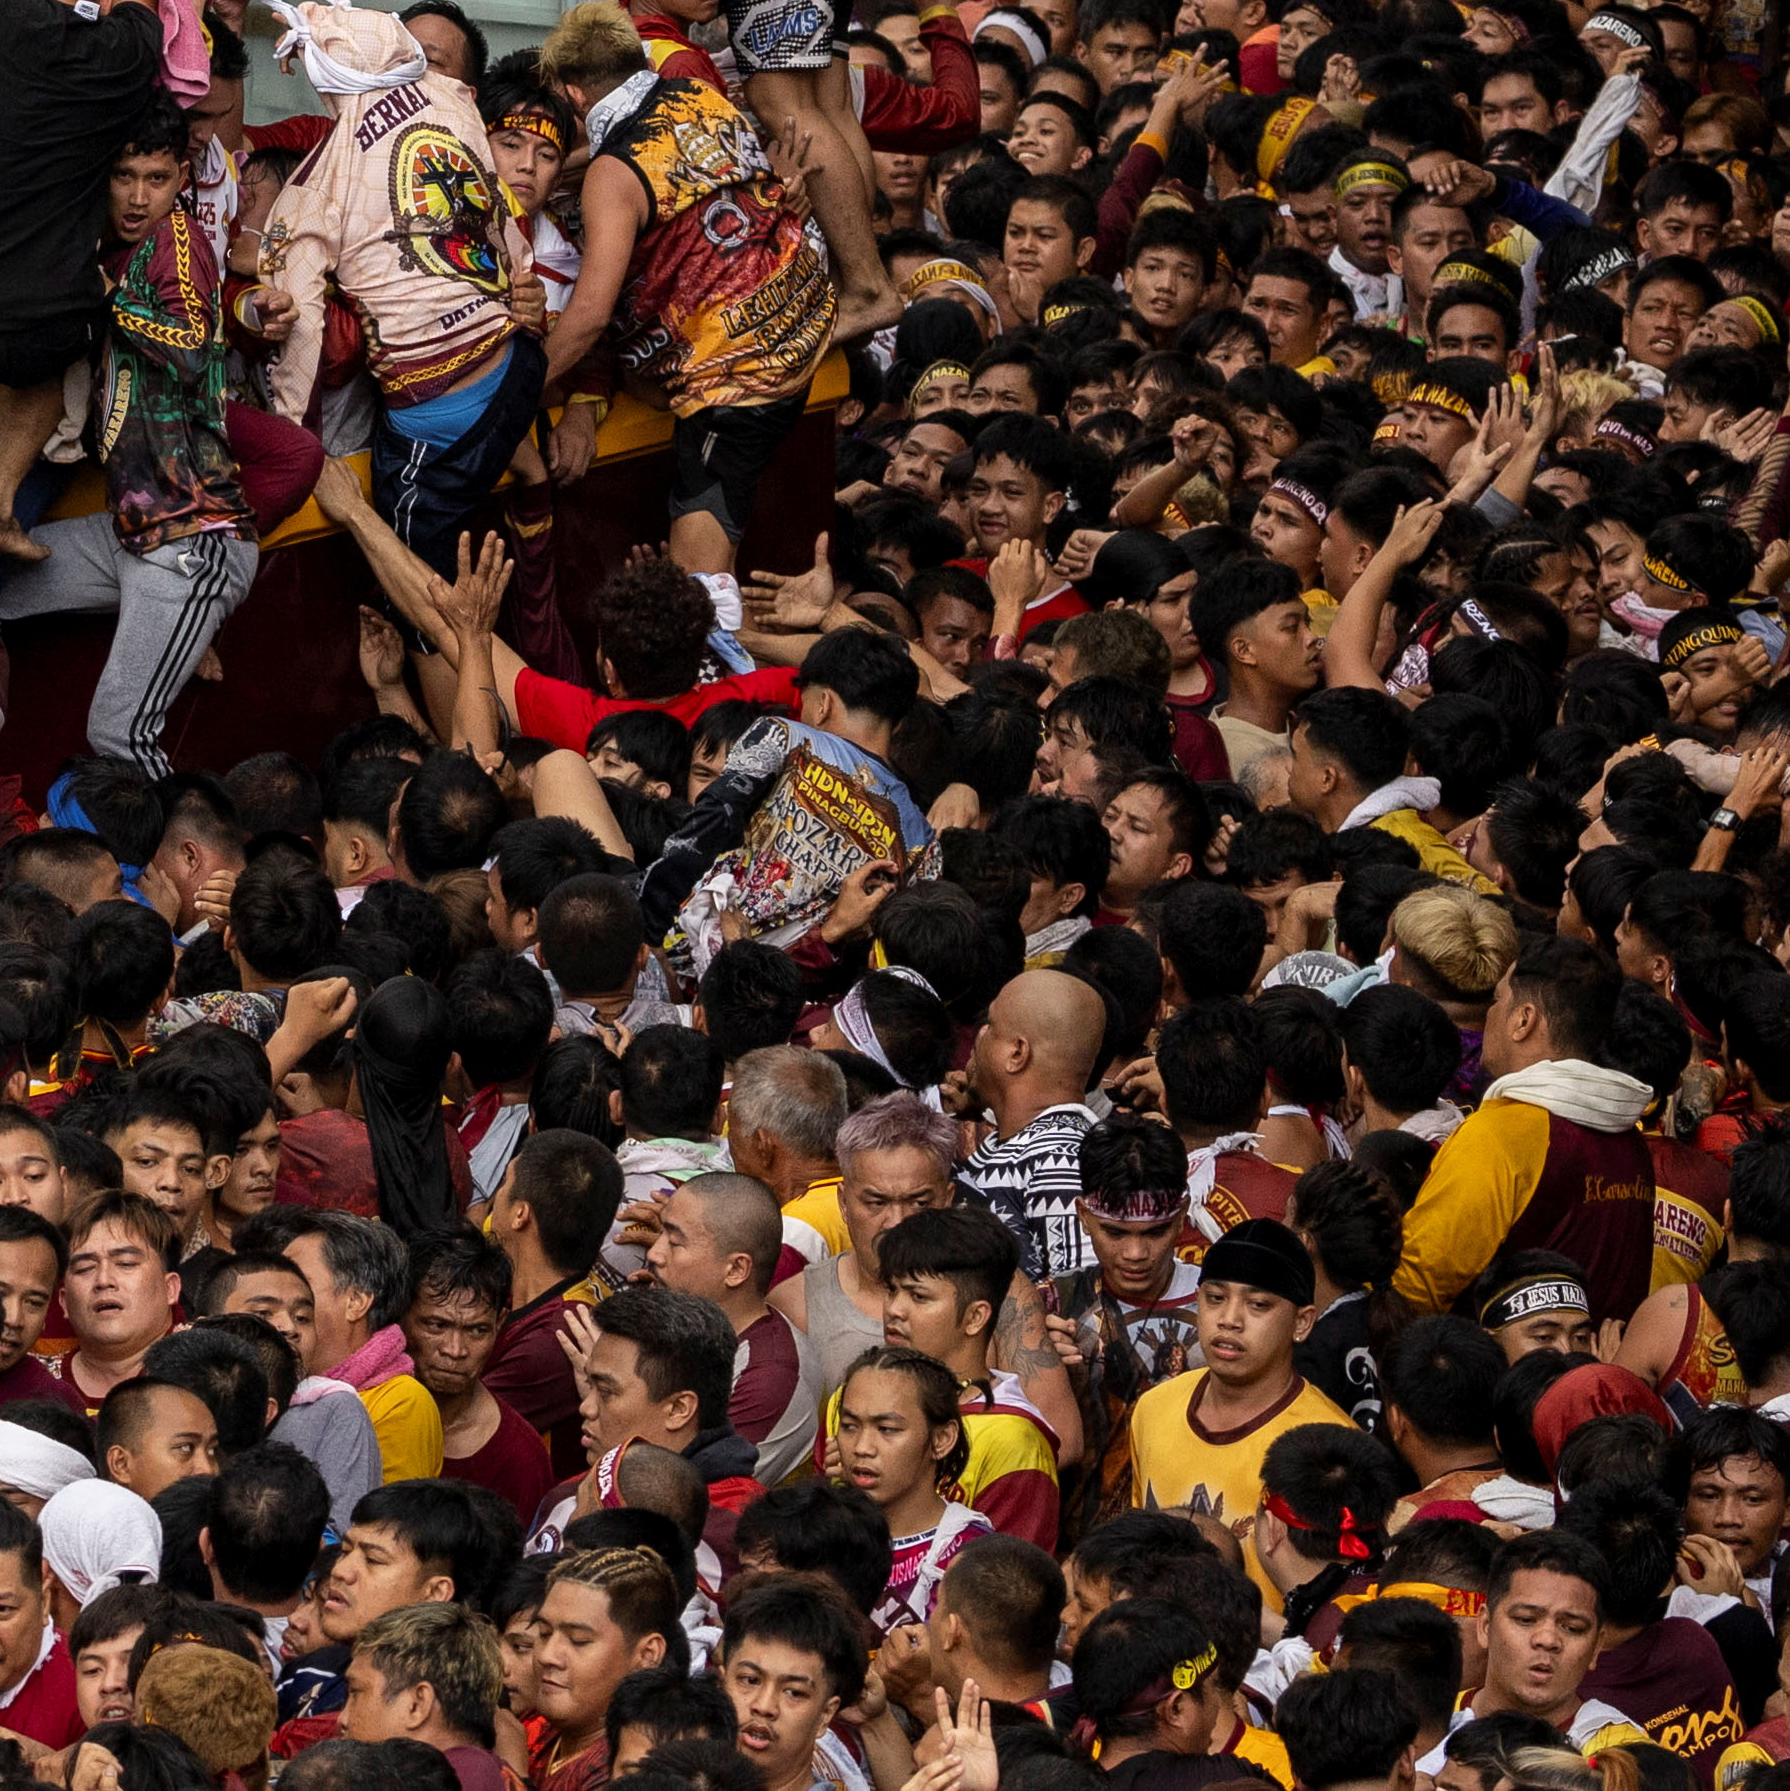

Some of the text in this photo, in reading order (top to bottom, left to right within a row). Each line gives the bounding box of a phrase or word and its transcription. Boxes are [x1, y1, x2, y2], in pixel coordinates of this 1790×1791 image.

[354, 80, 432, 153] BERNAL
[1268, 109, 1299, 142] JESUS
[1527, 1285, 1560, 1306] JESUS
[1644, 1704, 1690, 1731] KONSEHAL
